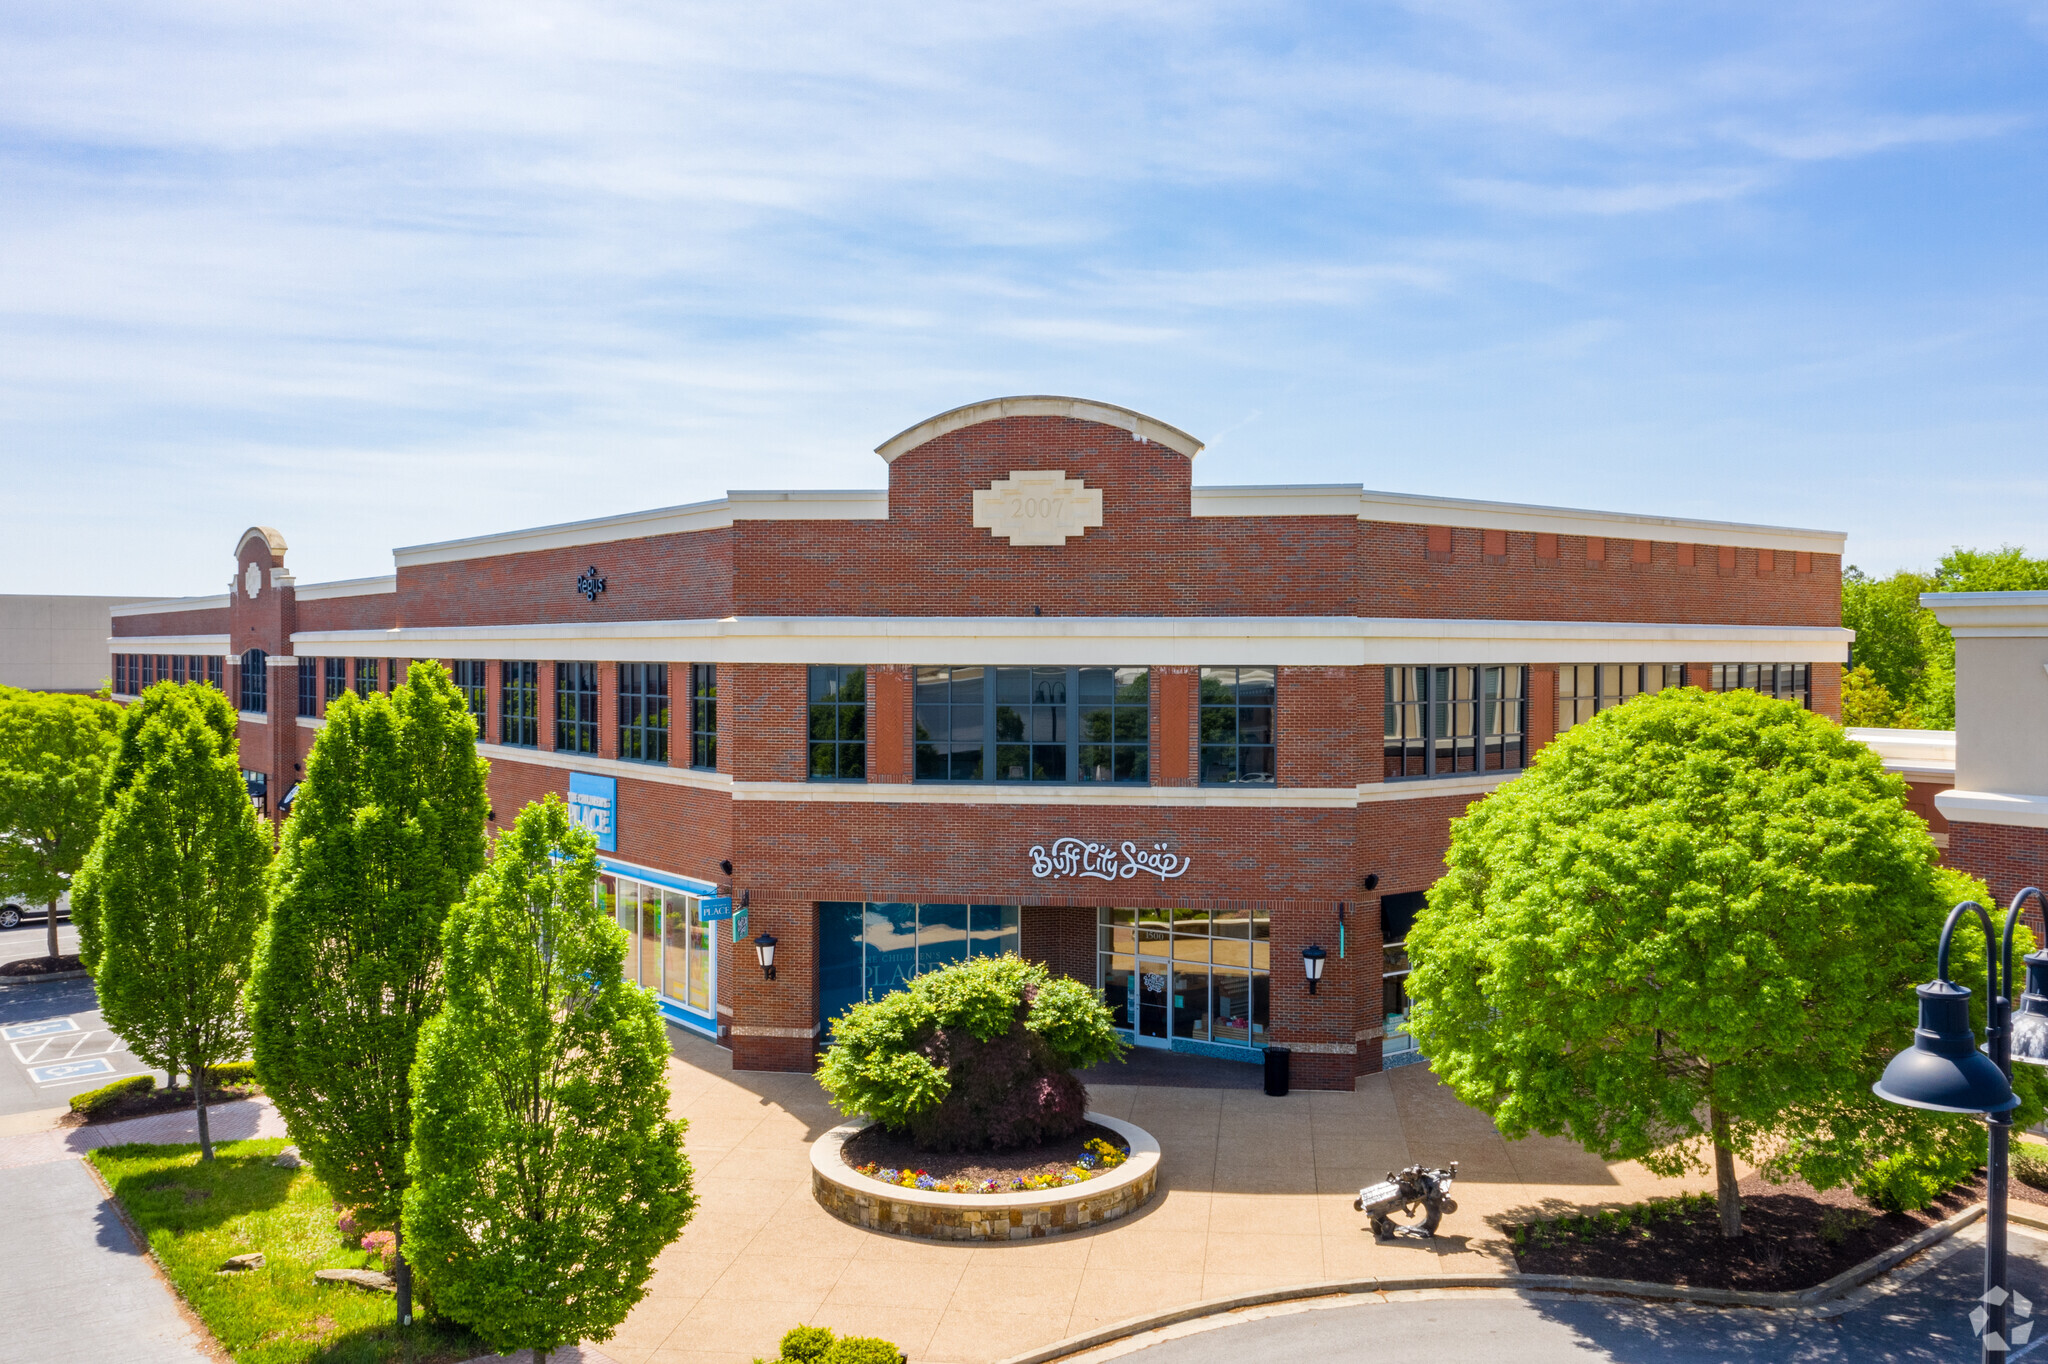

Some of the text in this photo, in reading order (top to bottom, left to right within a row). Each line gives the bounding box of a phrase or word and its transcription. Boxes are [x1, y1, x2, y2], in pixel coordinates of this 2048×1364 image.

[1011, 497, 1064, 519] 2007
[576, 575, 604, 602] Regus
[1029, 838, 1191, 882] Buff City Soap
[703, 906, 731, 917] PLACE
